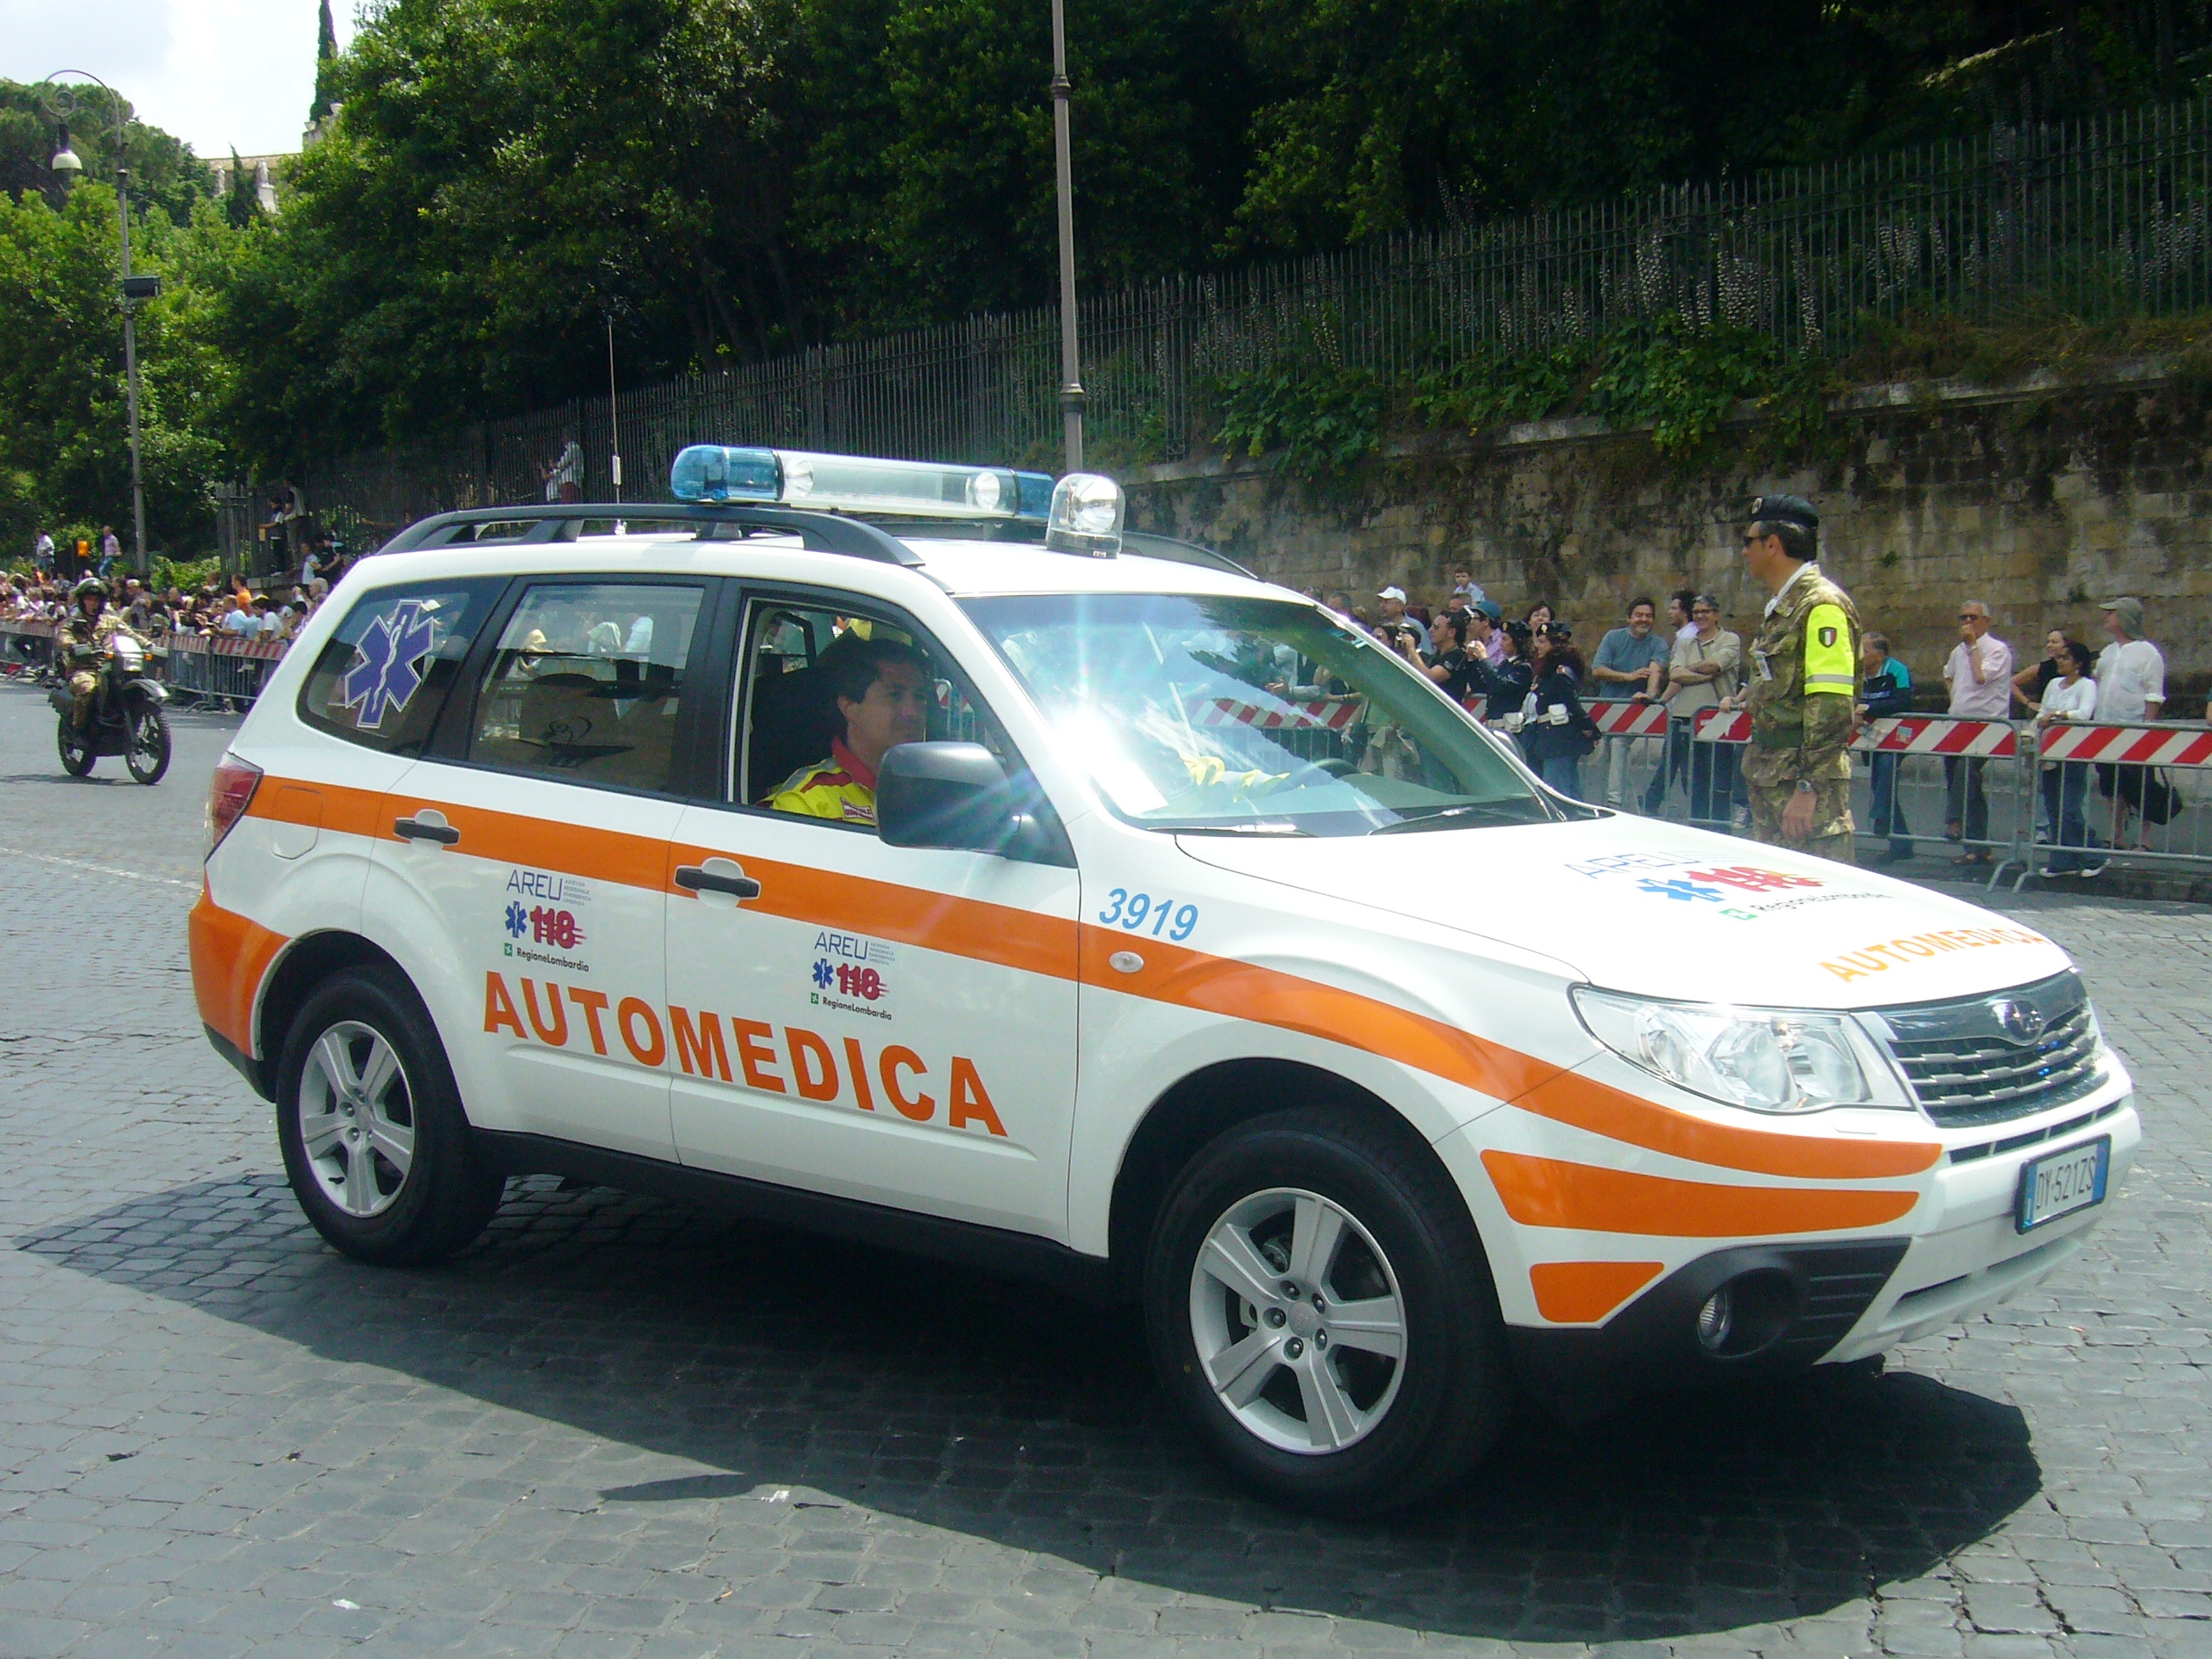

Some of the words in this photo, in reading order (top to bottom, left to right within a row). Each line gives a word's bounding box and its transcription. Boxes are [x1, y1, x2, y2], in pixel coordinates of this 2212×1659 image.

[1563, 851, 1702, 880] AREU
[506, 869, 563, 901] AREU
[529, 905, 584, 950] 118
[1099, 888, 1198, 941] 3919
[516, 947, 589, 971] RegioneLombardia
[814, 931, 868, 960] AREU
[1817, 928, 2053, 983] AUTOMEDICA
[836, 963, 885, 1000] 118
[822, 996, 892, 1020] RegioneLombardia
[484, 971, 1008, 1137] AUTOMEDICA
